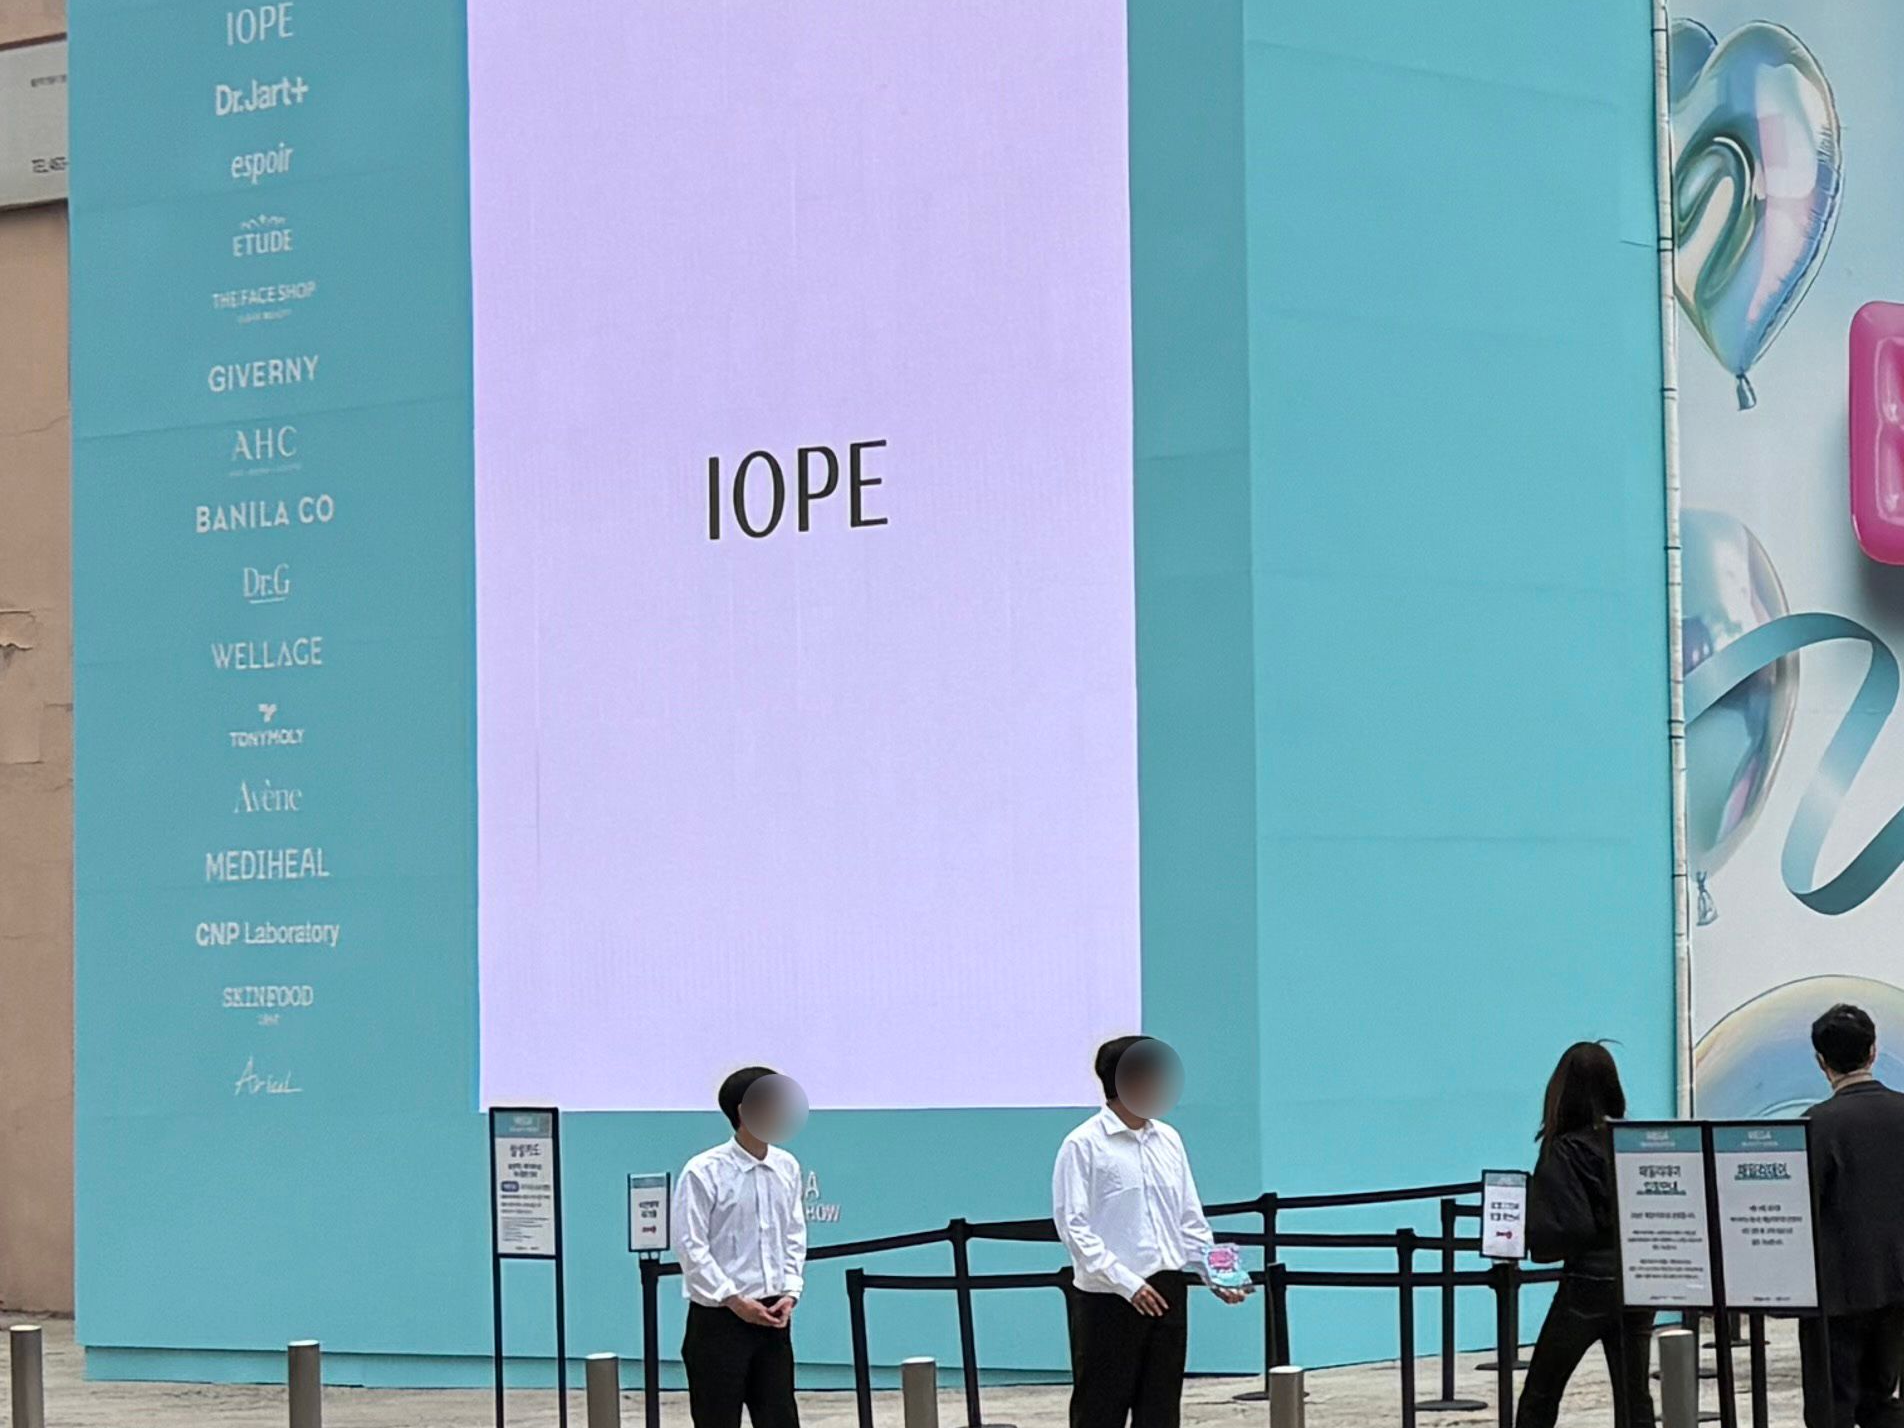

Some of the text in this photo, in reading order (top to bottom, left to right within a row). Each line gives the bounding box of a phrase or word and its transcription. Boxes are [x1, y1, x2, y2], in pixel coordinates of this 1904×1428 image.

[226, 1, 294, 46] IOPE
[215, 76, 309, 116] Dr.Jart+
[231, 142, 294, 185] espoir
[232, 229, 293, 257] ETUDE
[208, 355, 319, 393] GIVERNY
[231, 426, 298, 460] AHC
[708, 439, 888, 540] IOPE
[196, 494, 334, 534] BANILA CO
[211, 637, 323, 670] WELLAGE
[206, 847, 330, 882] MEDIHEAL
[196, 921, 339, 947] CNP Laboratory
[223, 985, 314, 1008] SKINFOOD
